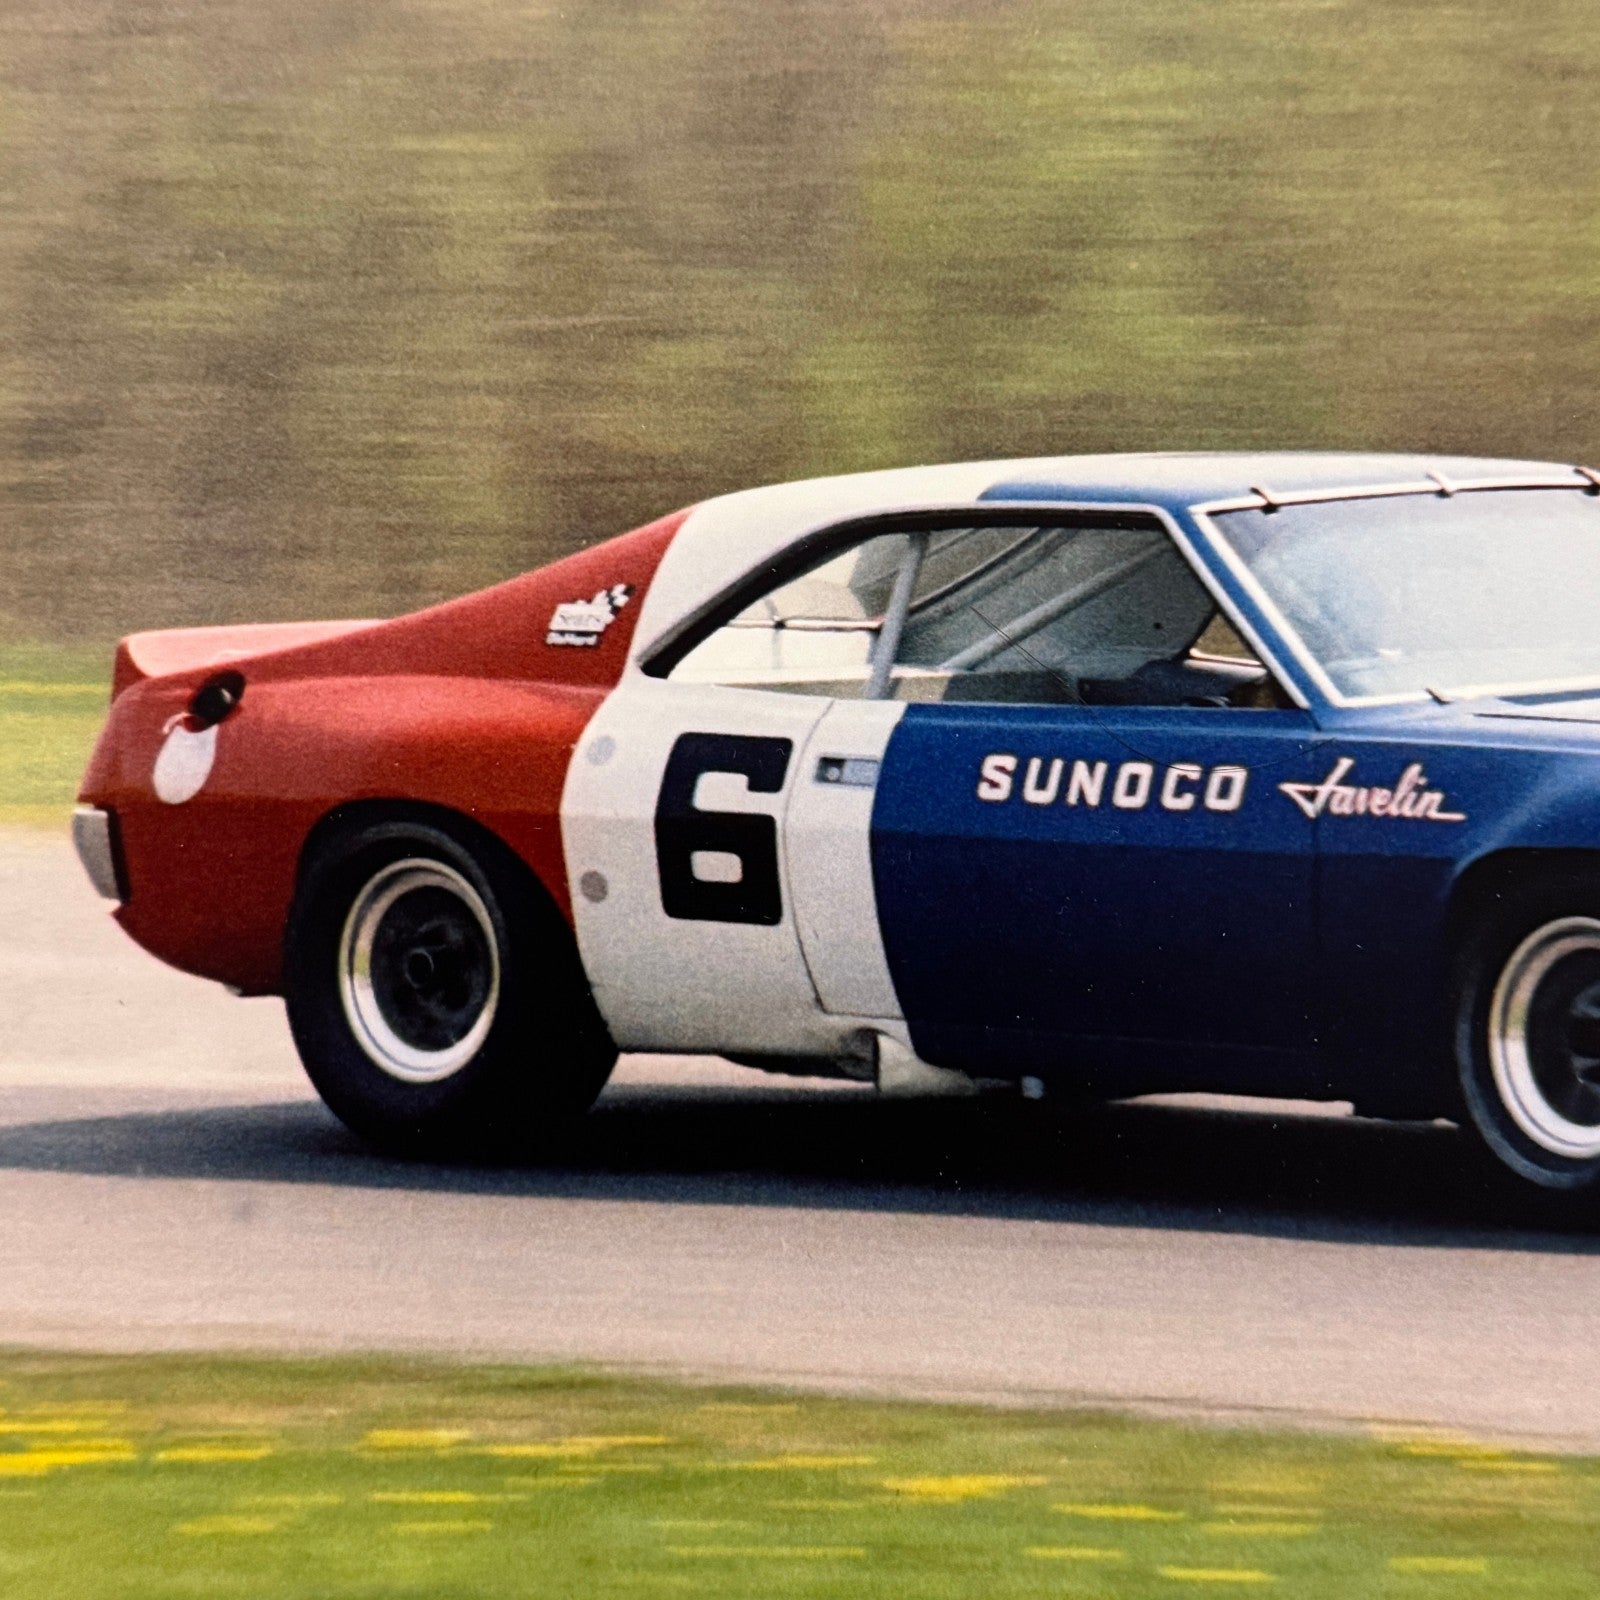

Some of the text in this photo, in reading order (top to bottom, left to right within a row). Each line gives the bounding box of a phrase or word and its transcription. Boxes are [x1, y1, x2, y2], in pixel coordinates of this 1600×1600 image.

[978, 753, 1248, 812] SUNOCO
[1278, 757, 1466, 822] Javelin
[654, 731, 793, 926] 6
